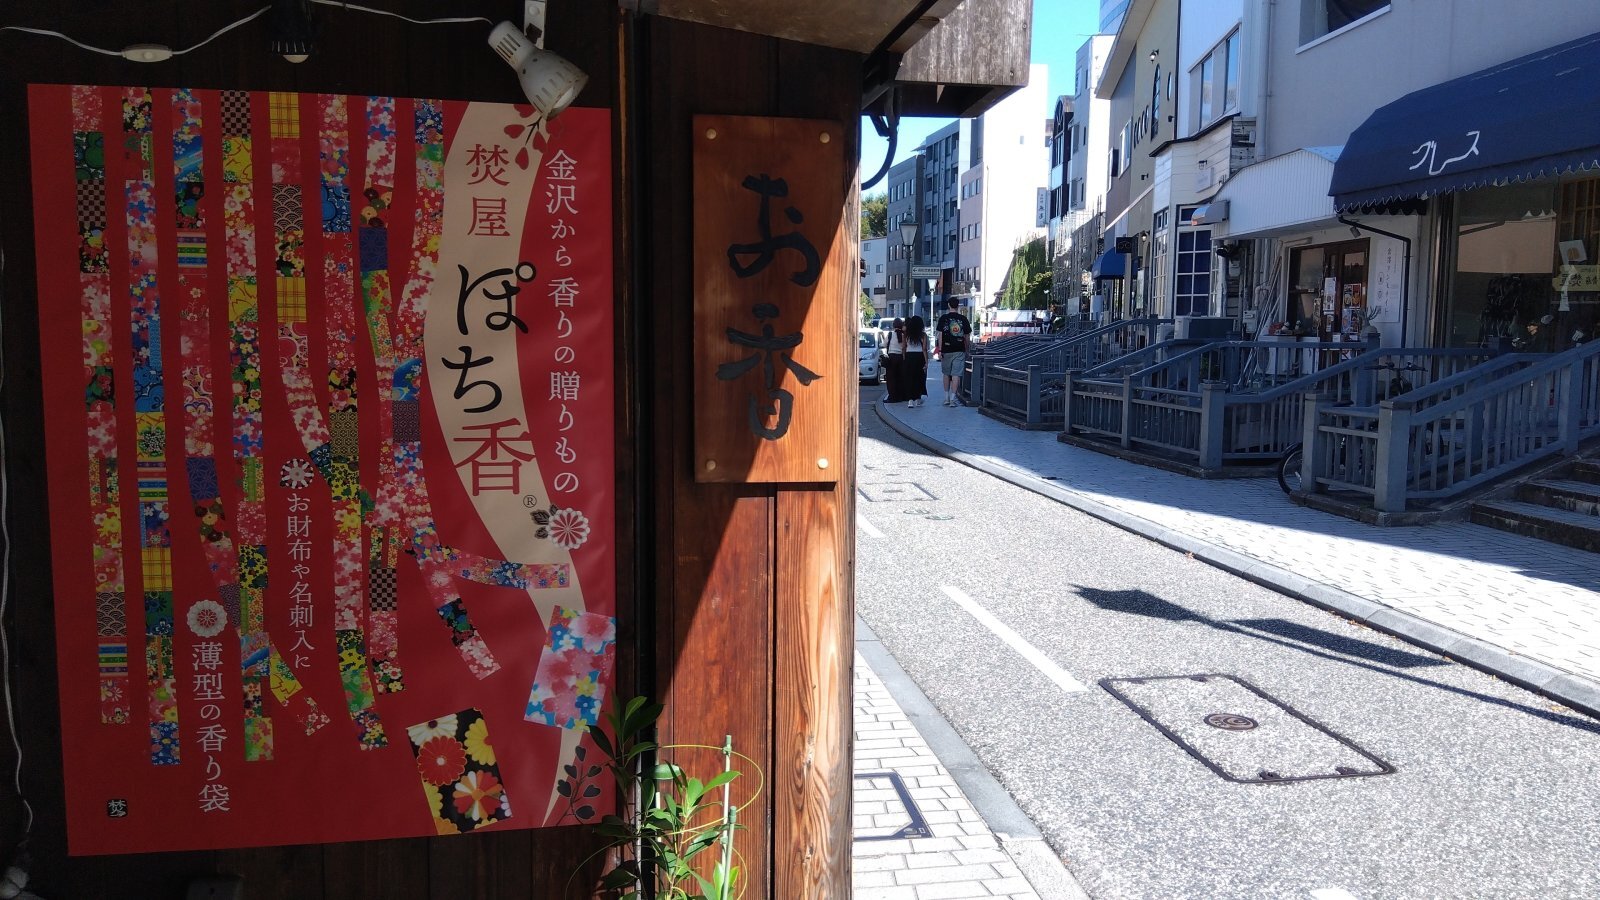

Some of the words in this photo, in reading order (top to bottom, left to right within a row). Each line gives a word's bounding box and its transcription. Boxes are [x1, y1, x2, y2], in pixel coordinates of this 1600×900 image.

[466, 143, 511, 237] 焚屋
[441, 261, 537, 497] ぽち香
[545, 149, 581, 493] 金沢から香りの贈りもの
[715, 172, 826, 441] お香
[286, 492, 316, 669] お財布や名刺入に
[191, 641, 231, 814] 薄型の香り袋
